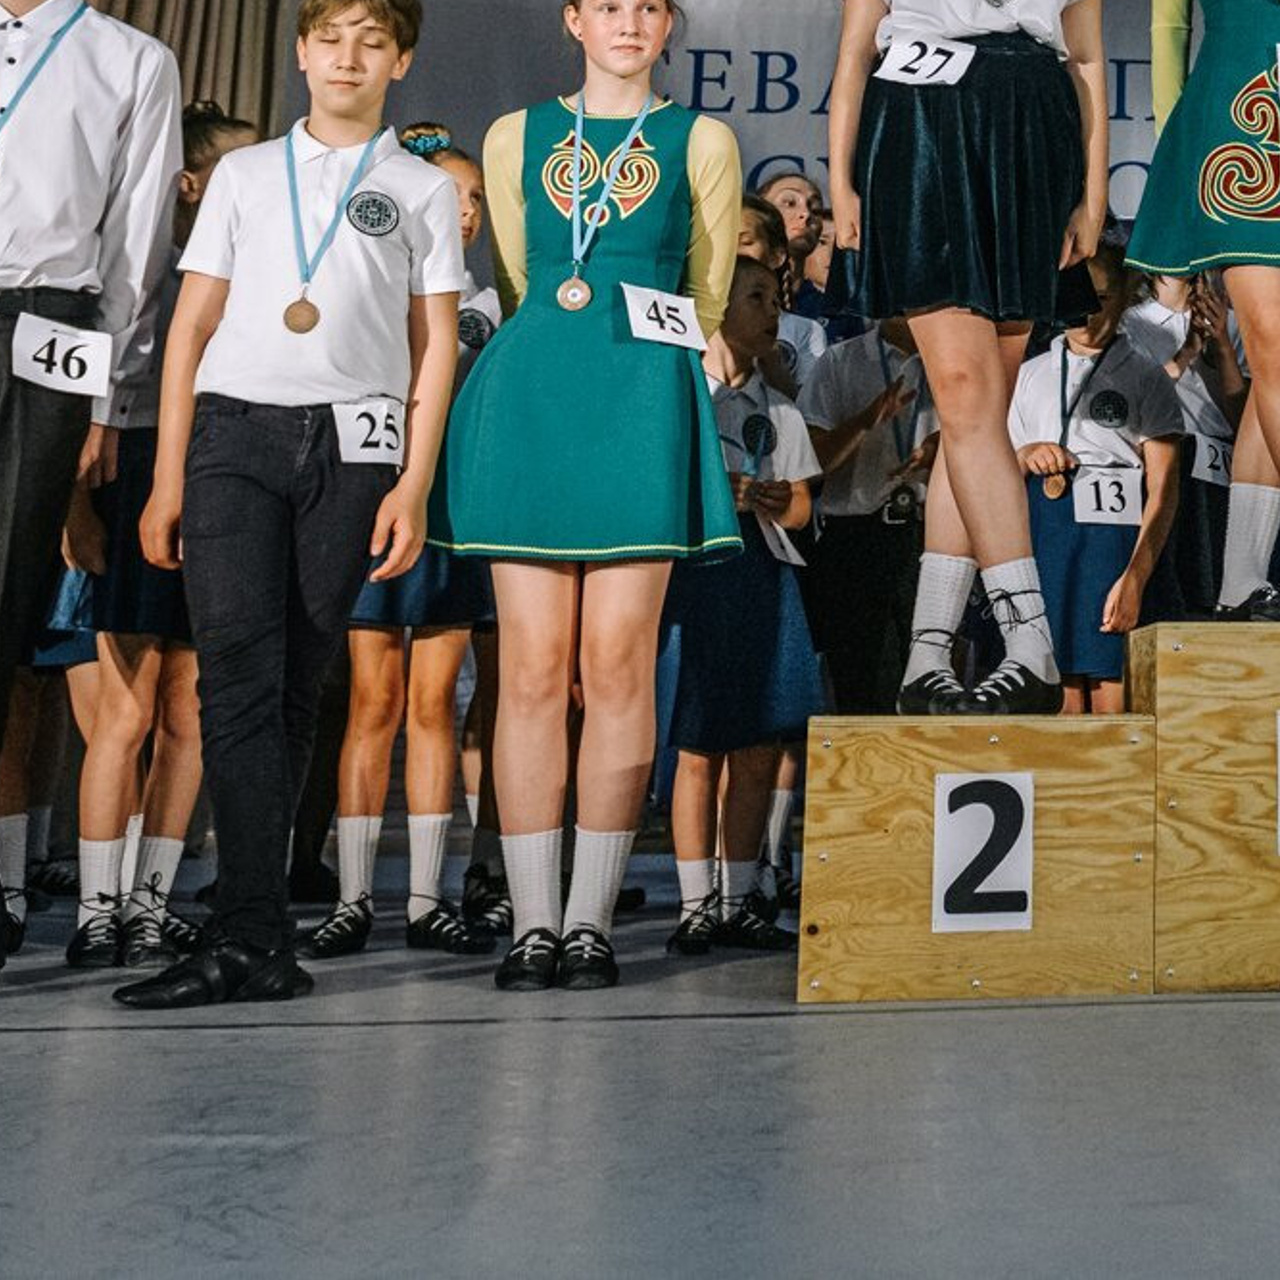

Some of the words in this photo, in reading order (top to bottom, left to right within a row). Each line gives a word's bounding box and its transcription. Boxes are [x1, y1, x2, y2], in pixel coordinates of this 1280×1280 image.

[898, 40, 955, 79] 27
[645, 299, 688, 335] 45
[32, 336, 90, 380] 46
[355, 411, 401, 451] 25
[1089, 479, 1127, 514] 13
[943, 779, 1029, 915] 2
